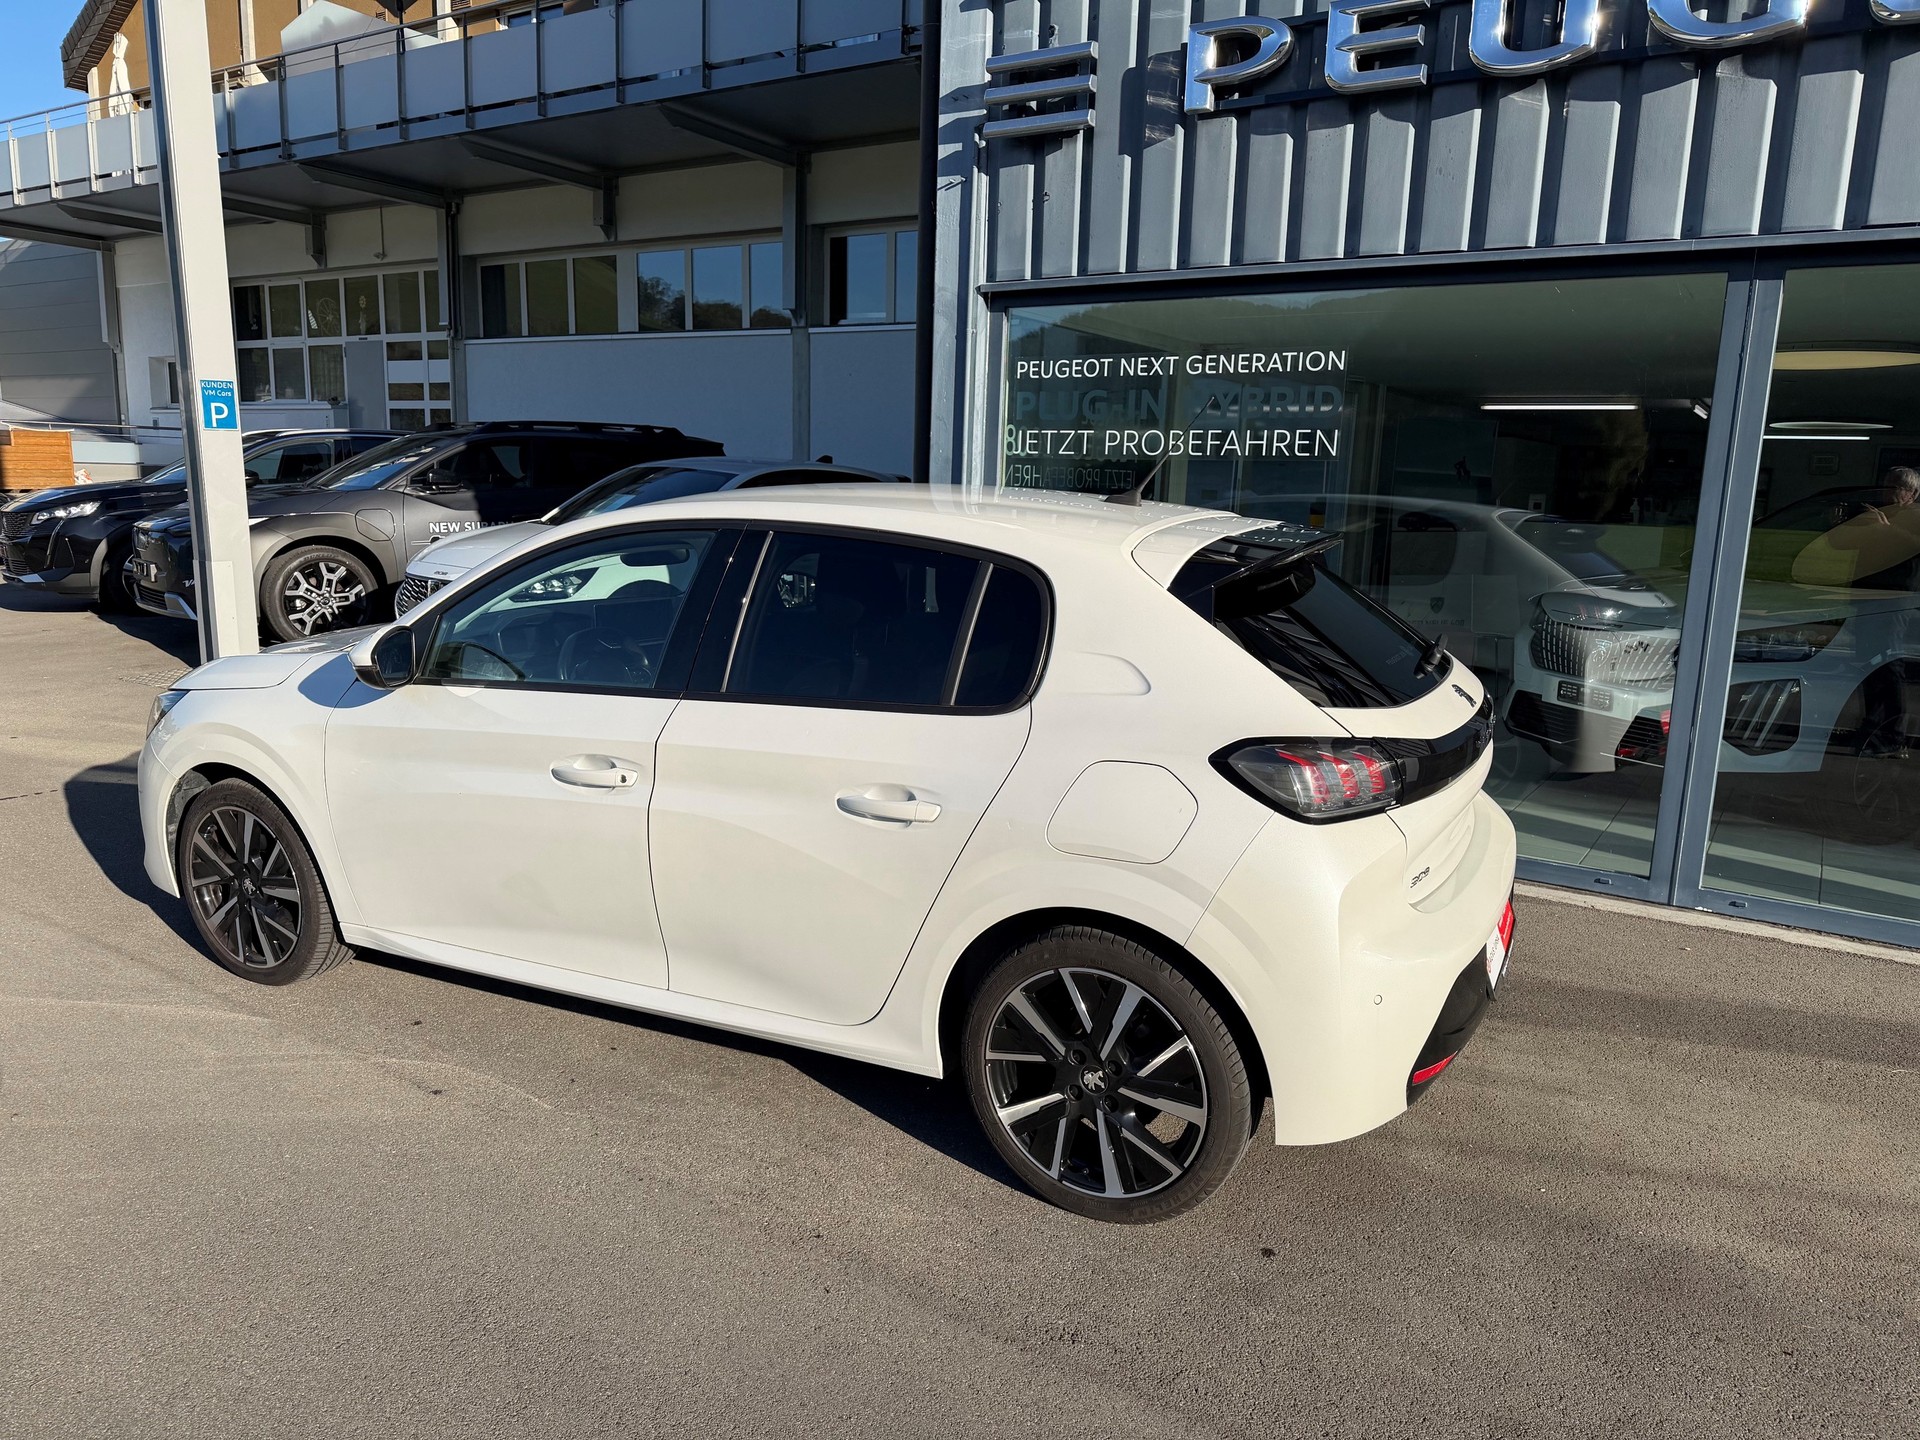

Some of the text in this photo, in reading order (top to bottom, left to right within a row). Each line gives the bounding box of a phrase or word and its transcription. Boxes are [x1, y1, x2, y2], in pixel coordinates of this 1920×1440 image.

[1016, 350, 1346, 379] PEUGEOT NEXT GENERATION
[201, 381, 233, 389] KUNDEN
[210, 402, 229, 427] P
[1012, 430, 1095, 455] JETZT
[1105, 429, 1339, 457] PROBEFAHREN
[429, 522, 460, 533] NEW
